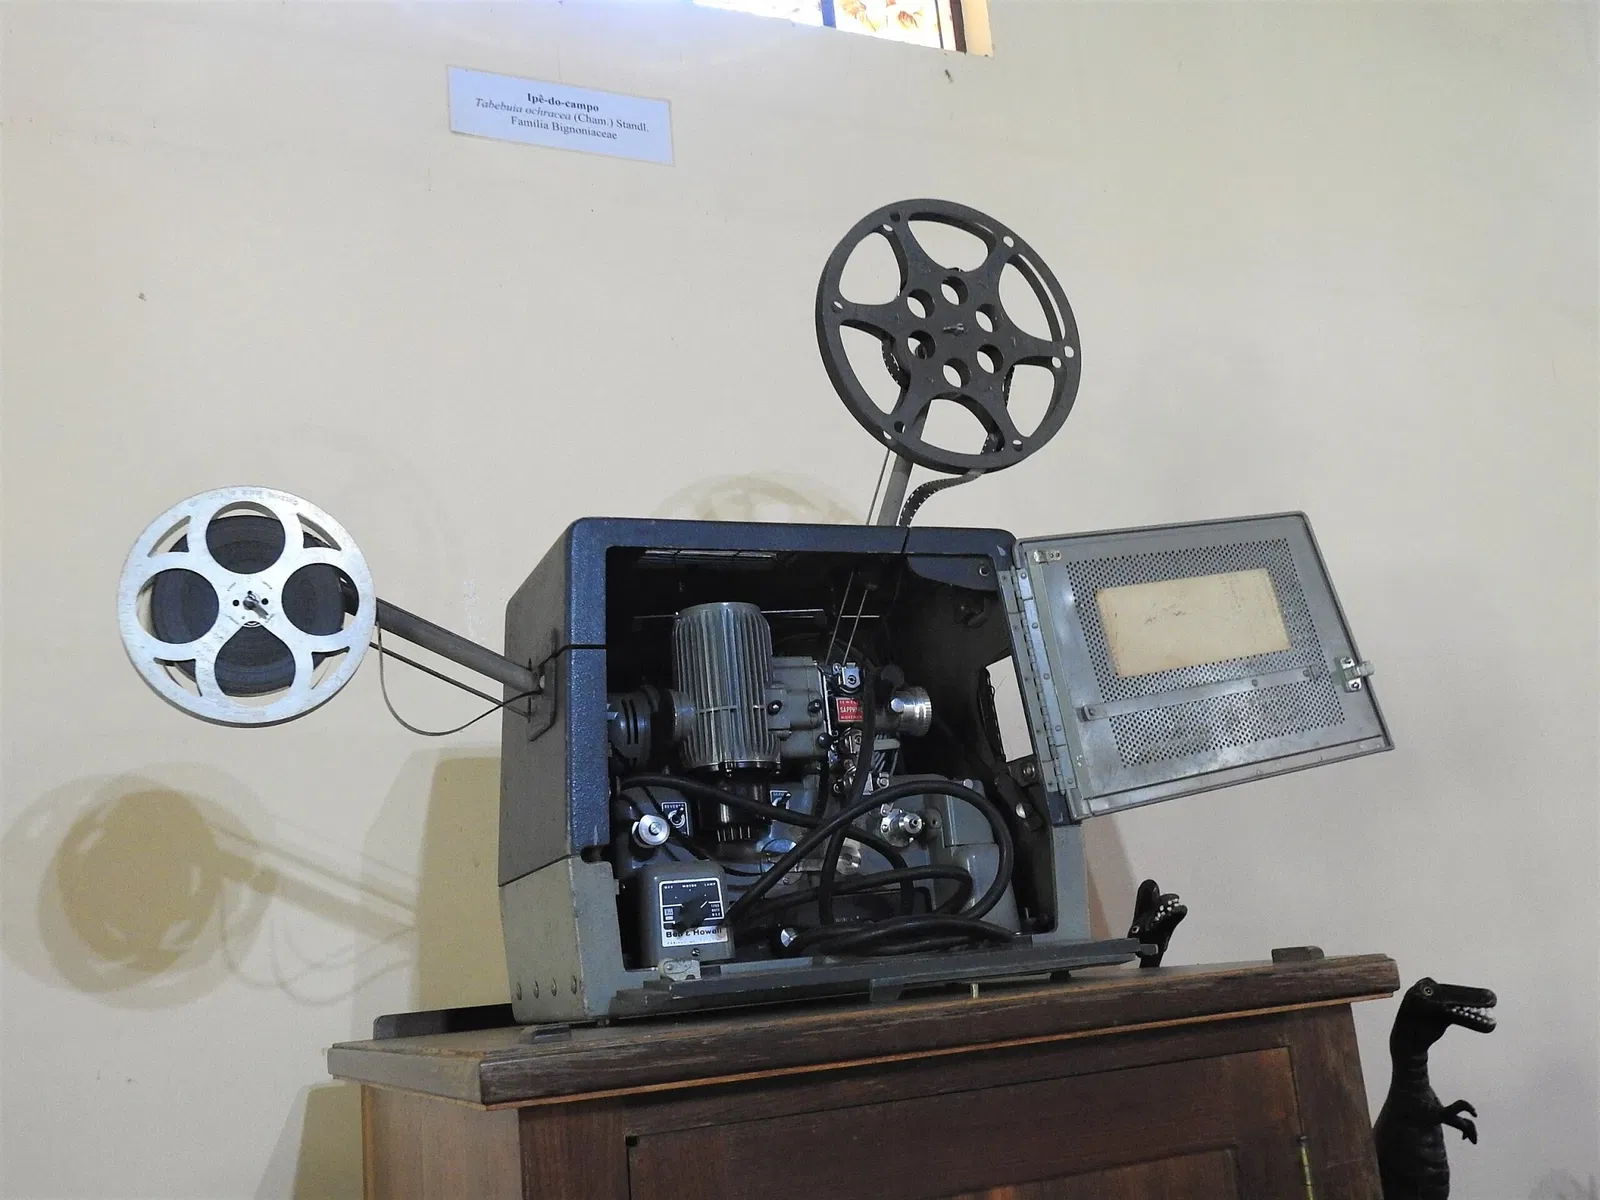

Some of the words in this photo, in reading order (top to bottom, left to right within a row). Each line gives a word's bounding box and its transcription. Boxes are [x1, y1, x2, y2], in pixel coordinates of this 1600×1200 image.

[475, 97, 523, 114] Tabebuia
[525, 106, 571, 121] ochracea
[574, 113, 614, 128] (Cham.)
[616, 116, 649, 132] Standl.
[527, 93, 599, 112] Ipê-do-campo
[511, 116, 549, 131] Família
[552, 122, 618, 140] Bignoniaceae
